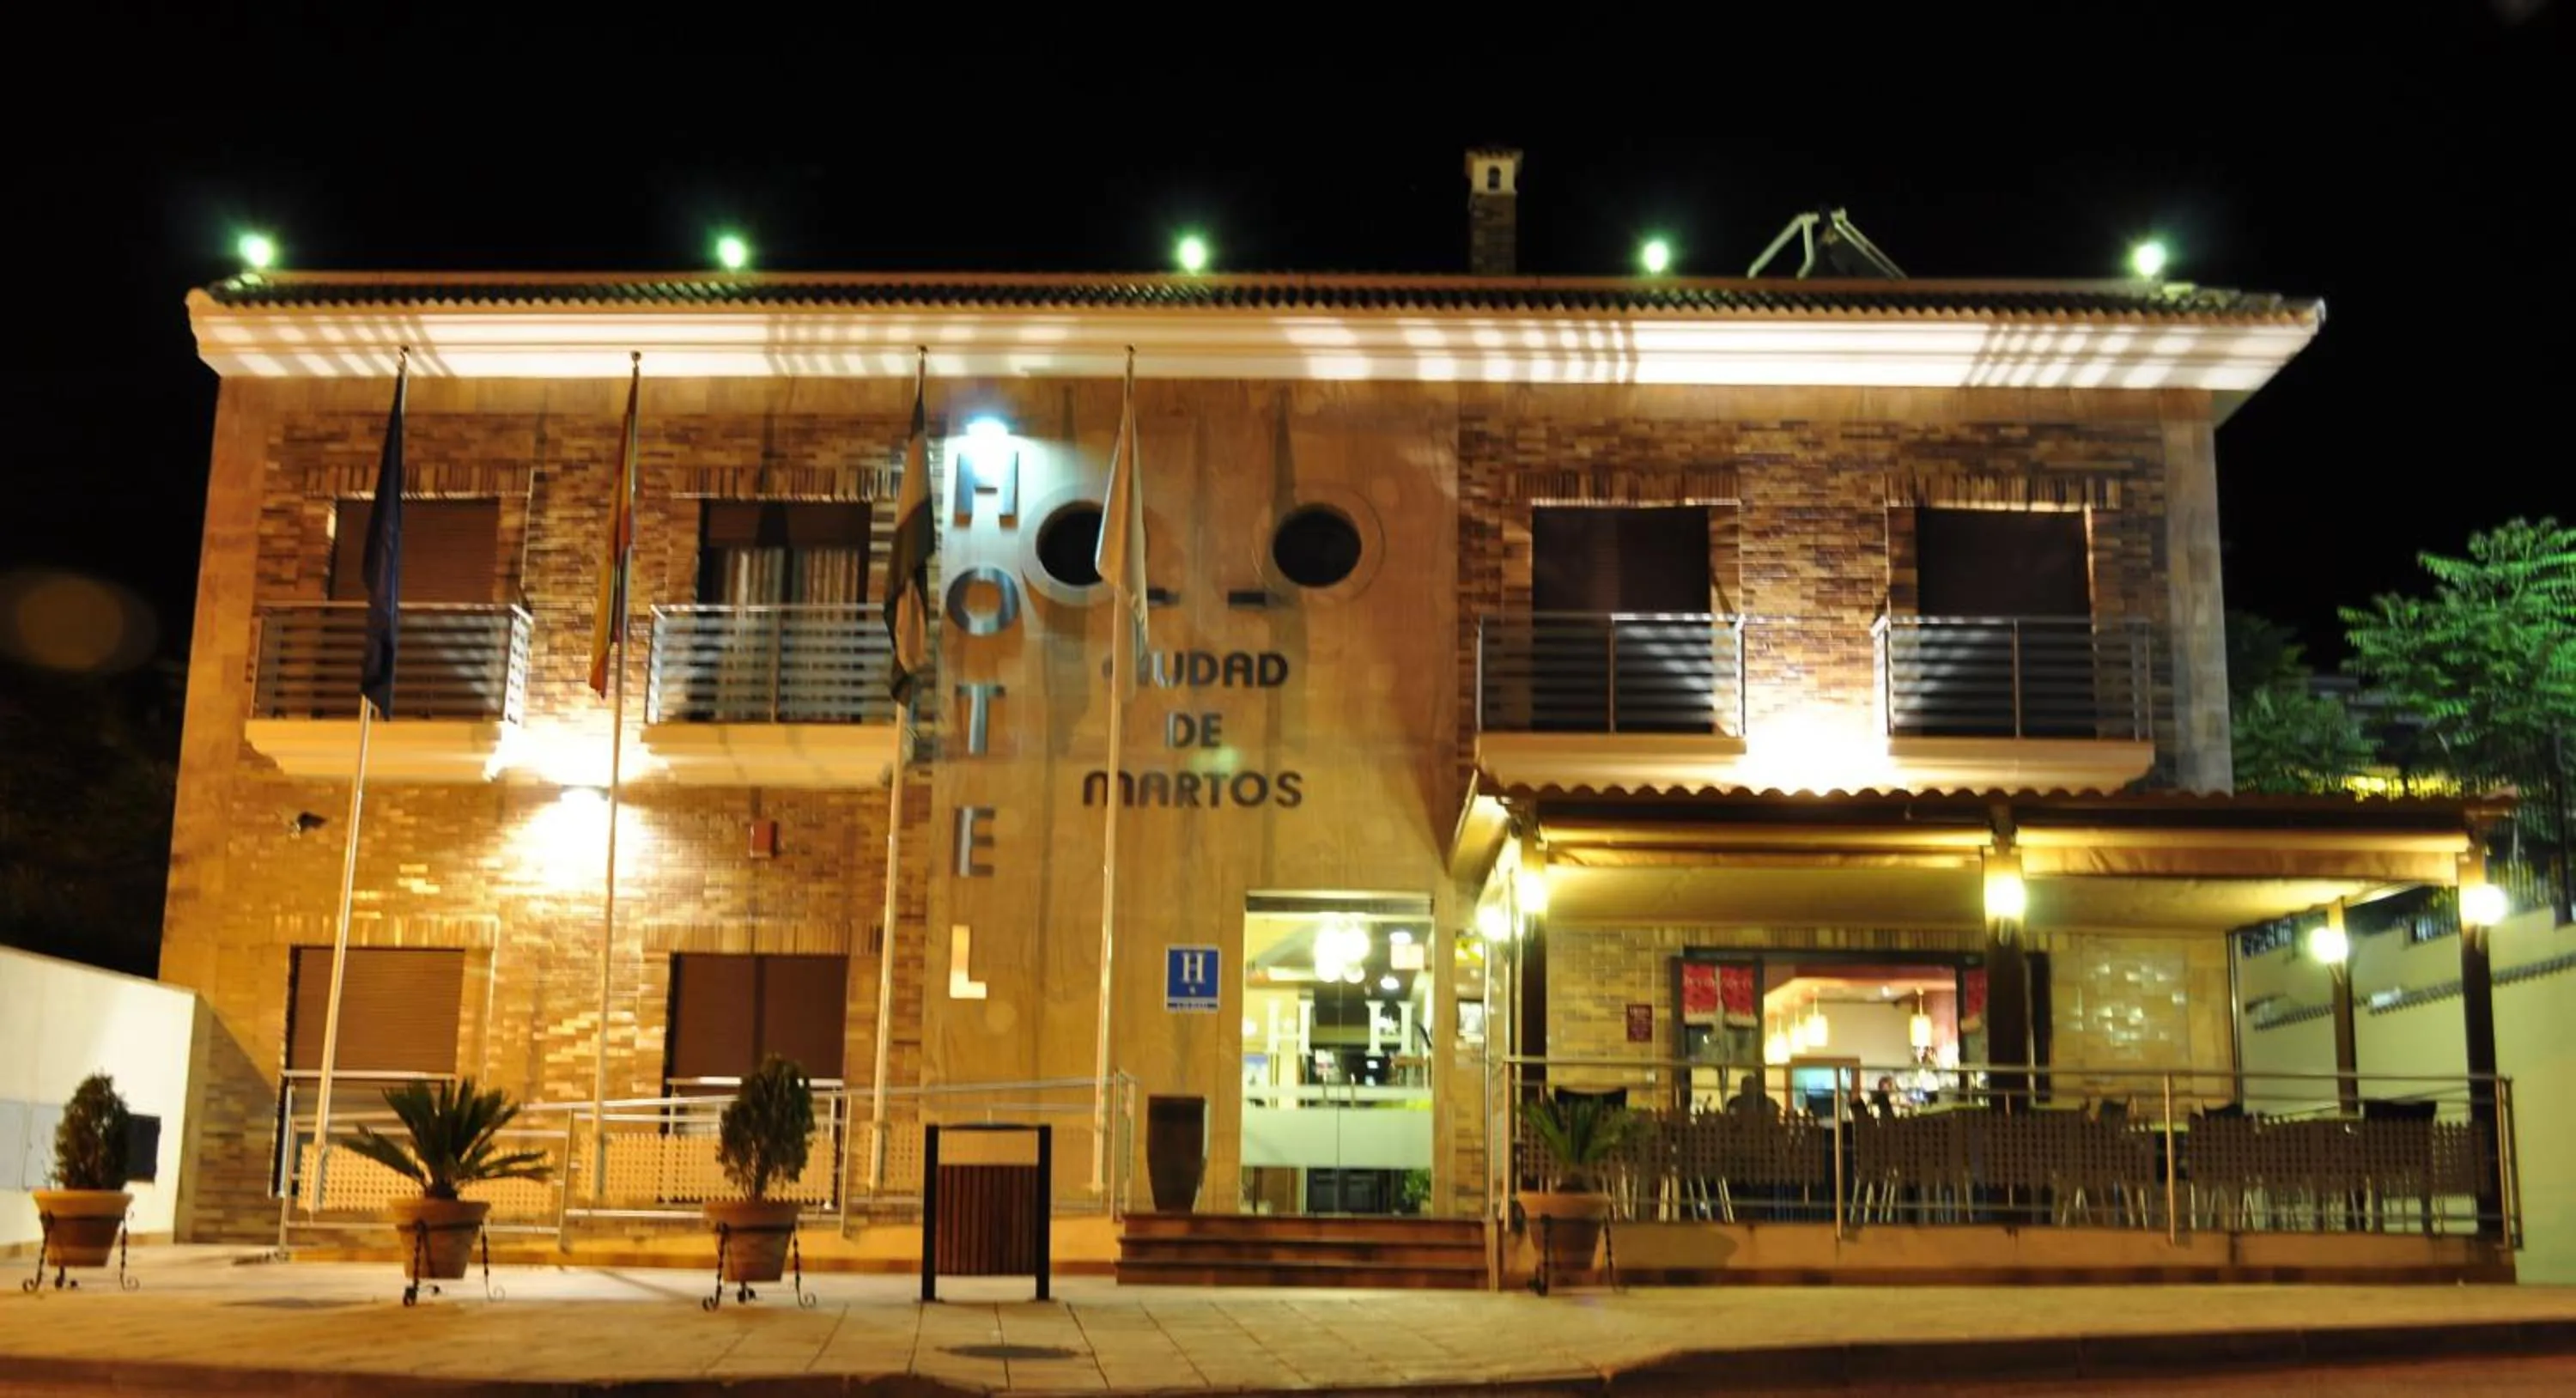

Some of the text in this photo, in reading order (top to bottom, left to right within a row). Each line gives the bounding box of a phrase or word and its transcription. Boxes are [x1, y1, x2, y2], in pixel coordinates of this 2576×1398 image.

[945, 447, 1020, 999] HOTEL
[1165, 712, 1222, 748] DE
[1083, 770, 1303, 807] MARTOS
[1182, 951, 1206, 983] H
[1365, 1000, 1415, 1056] H
